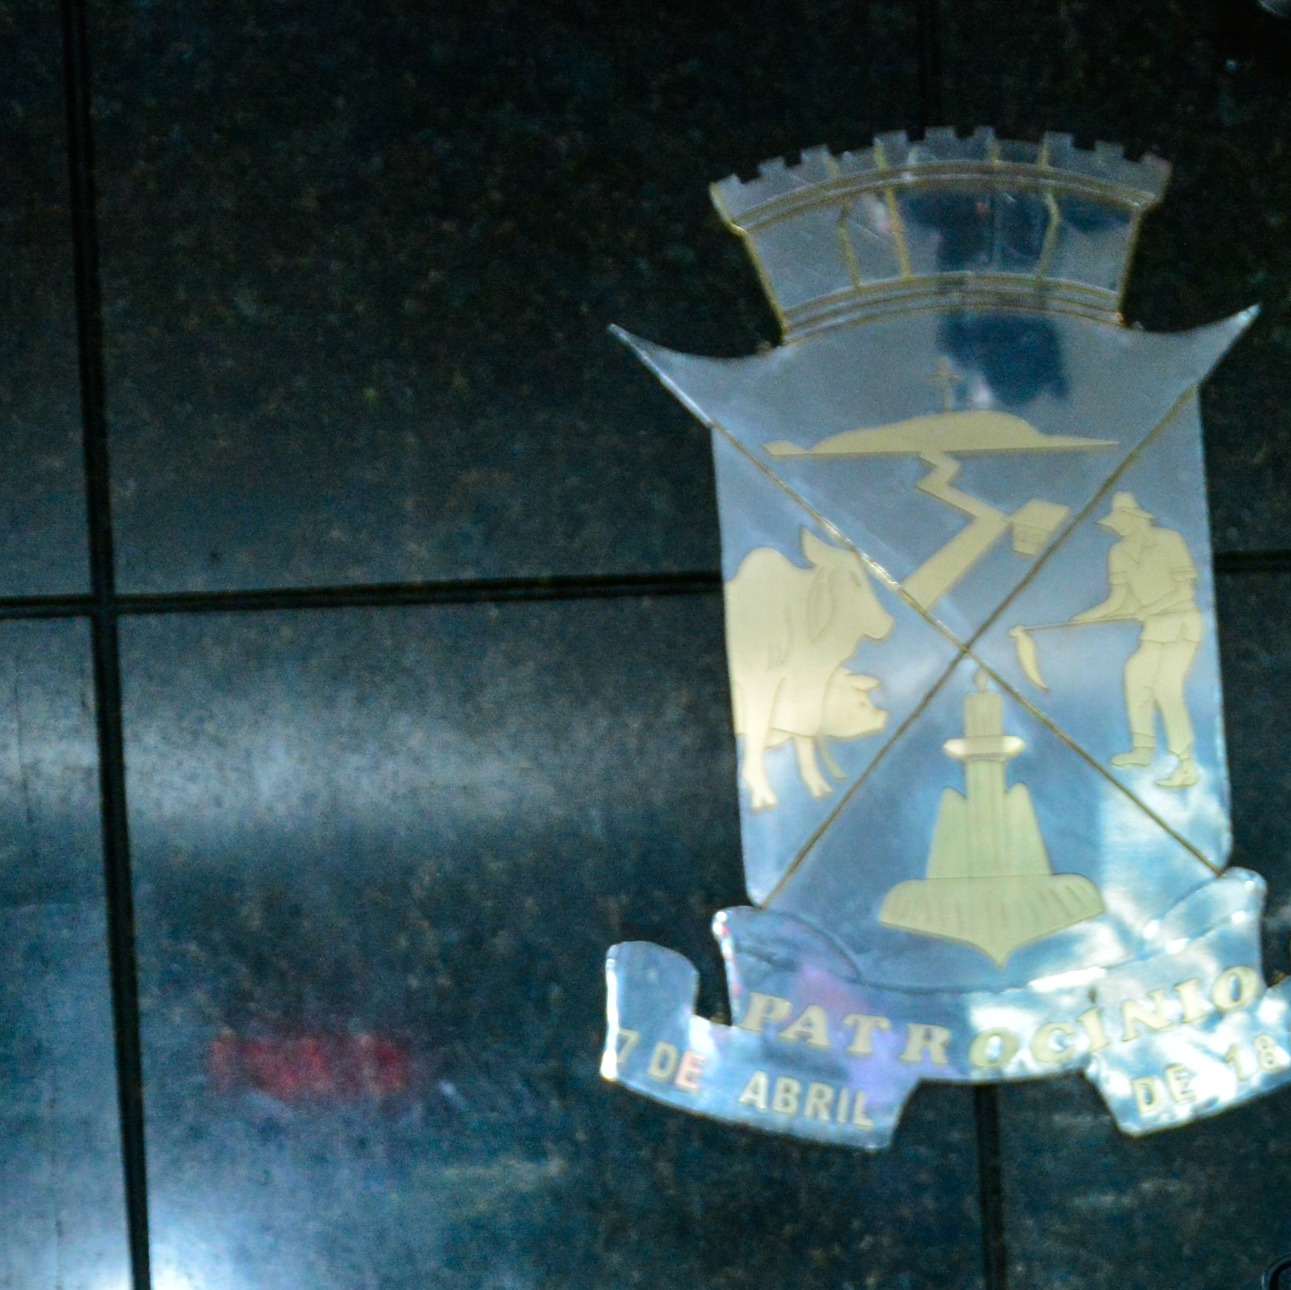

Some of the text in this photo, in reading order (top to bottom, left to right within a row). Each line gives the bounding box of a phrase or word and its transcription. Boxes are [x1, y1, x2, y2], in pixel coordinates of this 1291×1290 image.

[647, 1041, 708, 1093] DE
[737, 1070, 875, 1130] ABRIL
[1130, 1063, 1198, 1119] DE
